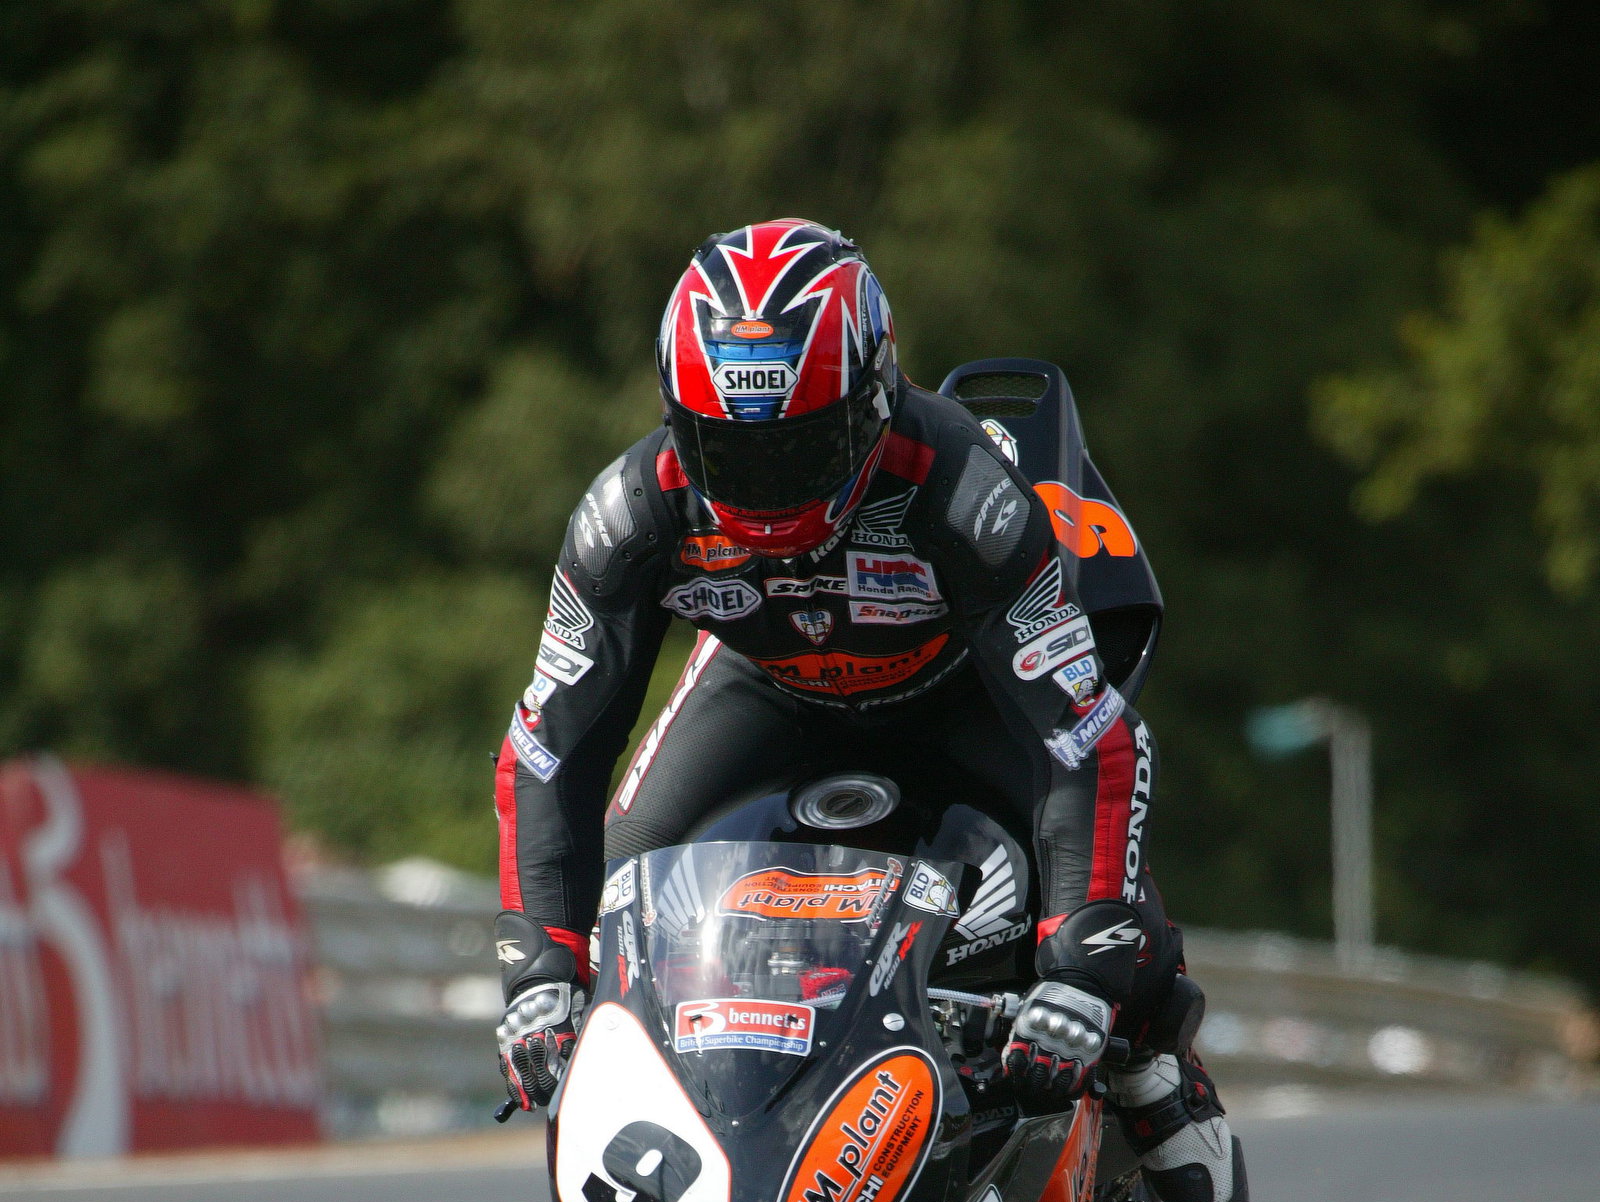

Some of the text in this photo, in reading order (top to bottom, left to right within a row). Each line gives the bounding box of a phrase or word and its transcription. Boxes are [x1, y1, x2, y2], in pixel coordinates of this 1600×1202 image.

[724, 369, 786, 390] SHOEI
[706, 542, 748, 561] plan
[676, 587, 743, 611] SHOEI
[857, 584, 894, 595] Honda
[545, 619, 583, 647] ONDA
[1017, 606, 1078, 641] HONDA
[1063, 659, 1093, 683] BLD
[1078, 690, 1120, 744] MICHE
[1121, 719, 1153, 905] HONDA
[621, 870, 632, 898] BLD
[909, 872, 930, 900] BLD
[736, 891, 831, 913] plant
[946, 913, 1032, 967] HONDA
[728, 1007, 806, 1031] bennetts
[680, 1036, 804, 1051] Briti Superbike Championship
[836, 1071, 902, 1179] plant
[873, 1089, 924, 1172] CONSTRUCTION
[882, 1117, 922, 1179] EQUIPMENT
